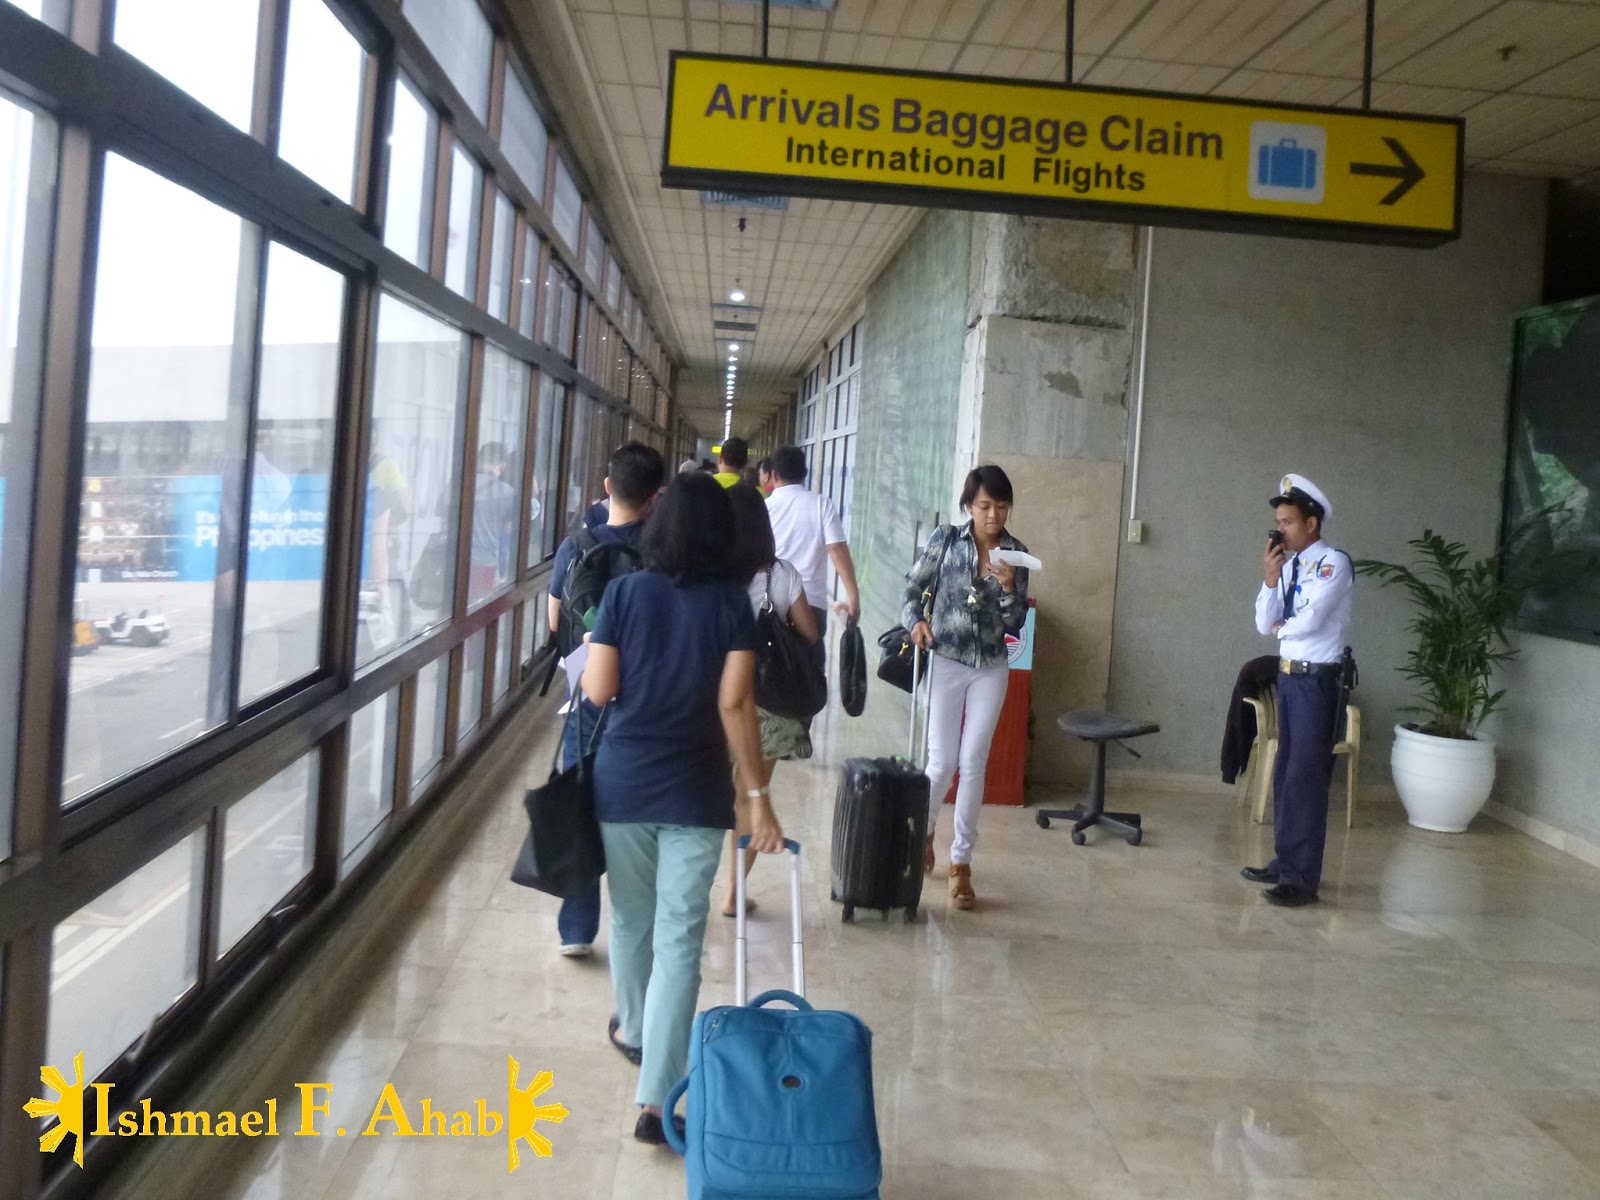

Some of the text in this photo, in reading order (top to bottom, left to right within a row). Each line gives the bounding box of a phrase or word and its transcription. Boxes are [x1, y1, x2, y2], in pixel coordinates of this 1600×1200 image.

[704, 82, 1223, 160] Arrivals Baggage Claim
[786, 137, 1146, 193] International Flights
